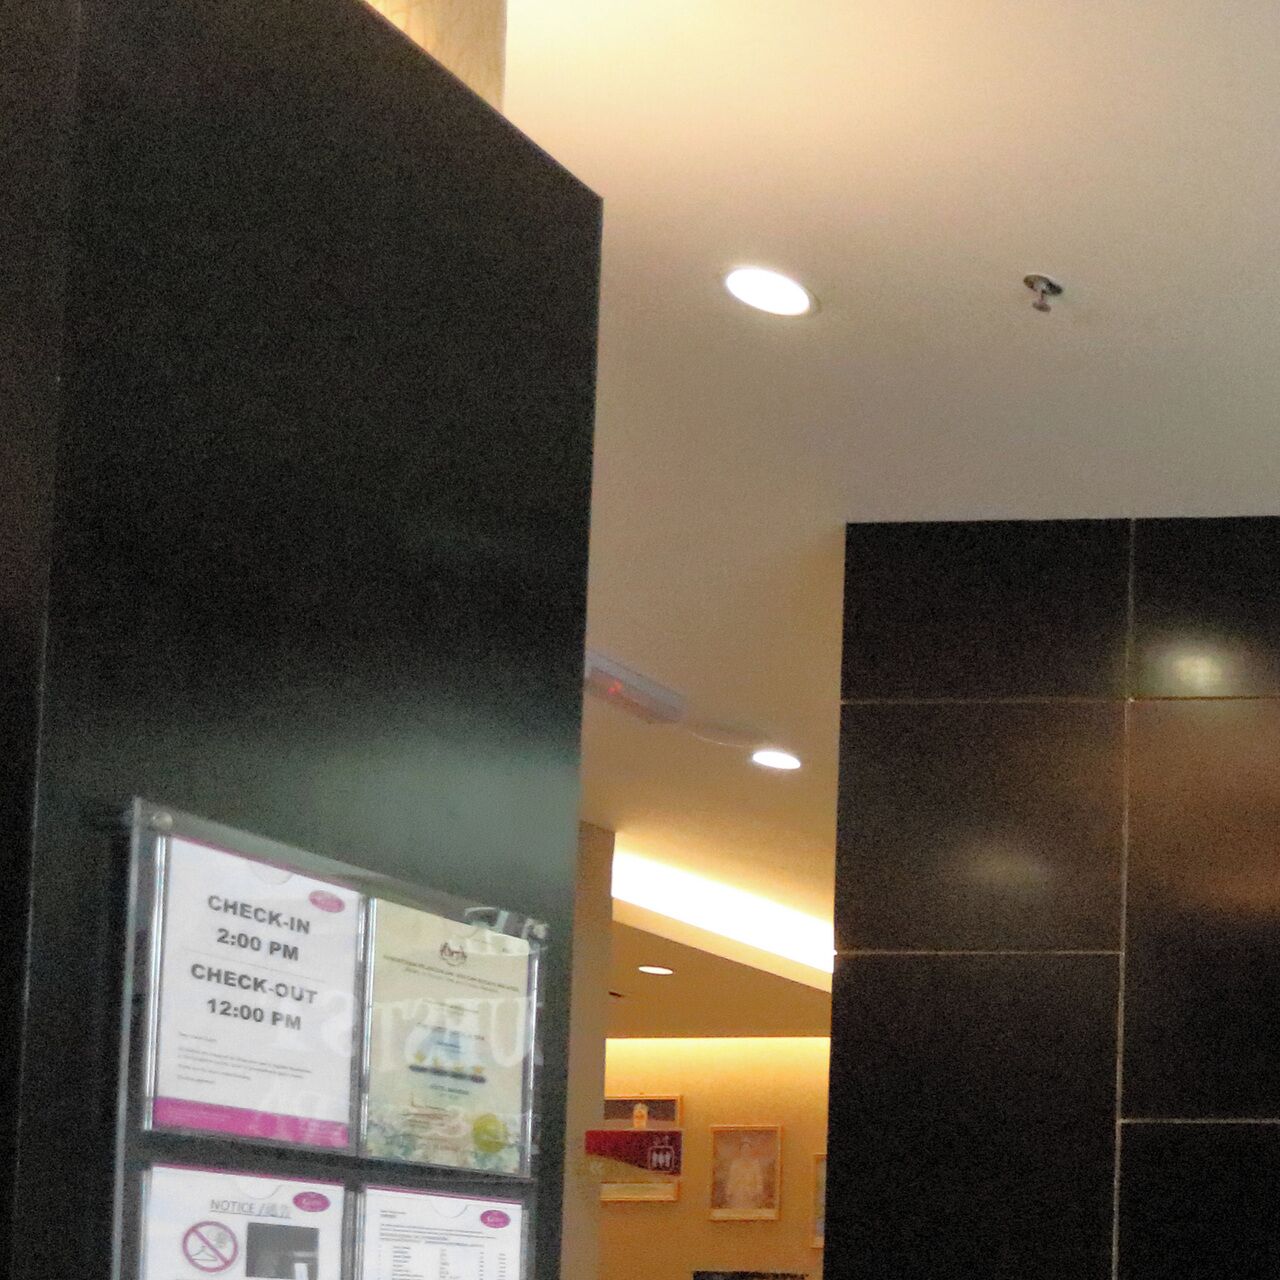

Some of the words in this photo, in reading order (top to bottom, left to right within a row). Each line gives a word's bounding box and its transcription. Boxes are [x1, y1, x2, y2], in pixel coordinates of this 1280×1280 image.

[207, 894, 311, 935] CHECK-IN
[217, 927, 262, 952] 2:00
[269, 940, 299, 961] PM
[190, 963, 318, 1004] CHECK-OUT
[207, 998, 264, 1023] 12:00
[271, 1010, 302, 1031] PM
[209, 1198, 255, 1214] NOTICE
